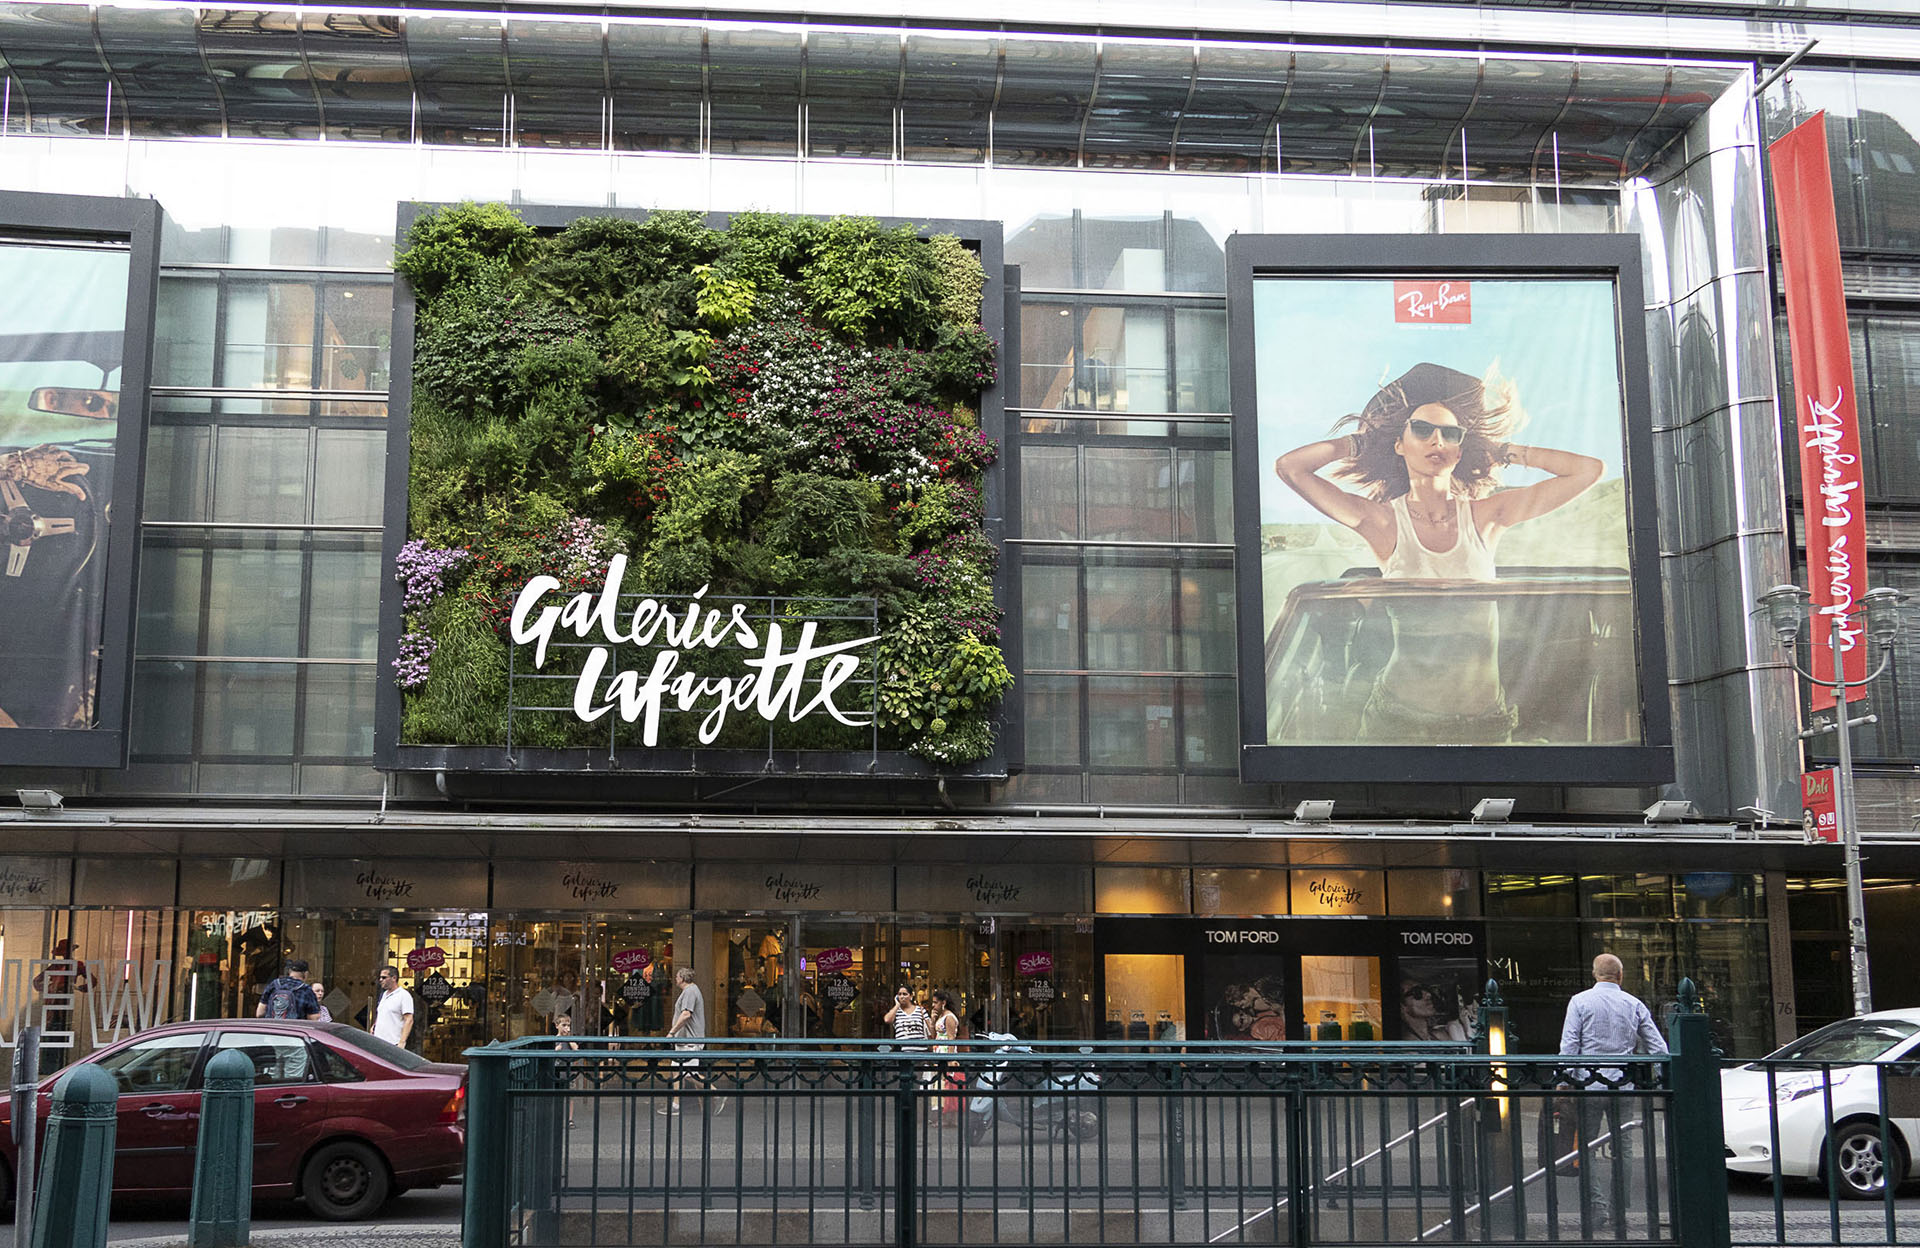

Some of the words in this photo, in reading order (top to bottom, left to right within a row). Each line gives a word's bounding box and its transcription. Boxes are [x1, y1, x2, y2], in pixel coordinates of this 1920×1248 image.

[1398, 283, 1467, 318] Ray-Ban
[1804, 385, 1858, 527] Lafayette
[510, 553, 758, 670] Galeries
[574, 622, 881, 747] Lafayette
[1205, 930, 1237, 943] TOM
[1240, 930, 1279, 943] FORD
[1400, 932, 1432, 945] TOM
[1434, 932, 1473, 945] FORD
[408, 950, 442, 967] Soldes
[614, 952, 648, 968] Soldes
[818, 951, 850, 968] Soldes
[1019, 954, 1052, 970] Soldes
[1776, 1001, 1793, 1016] 76
